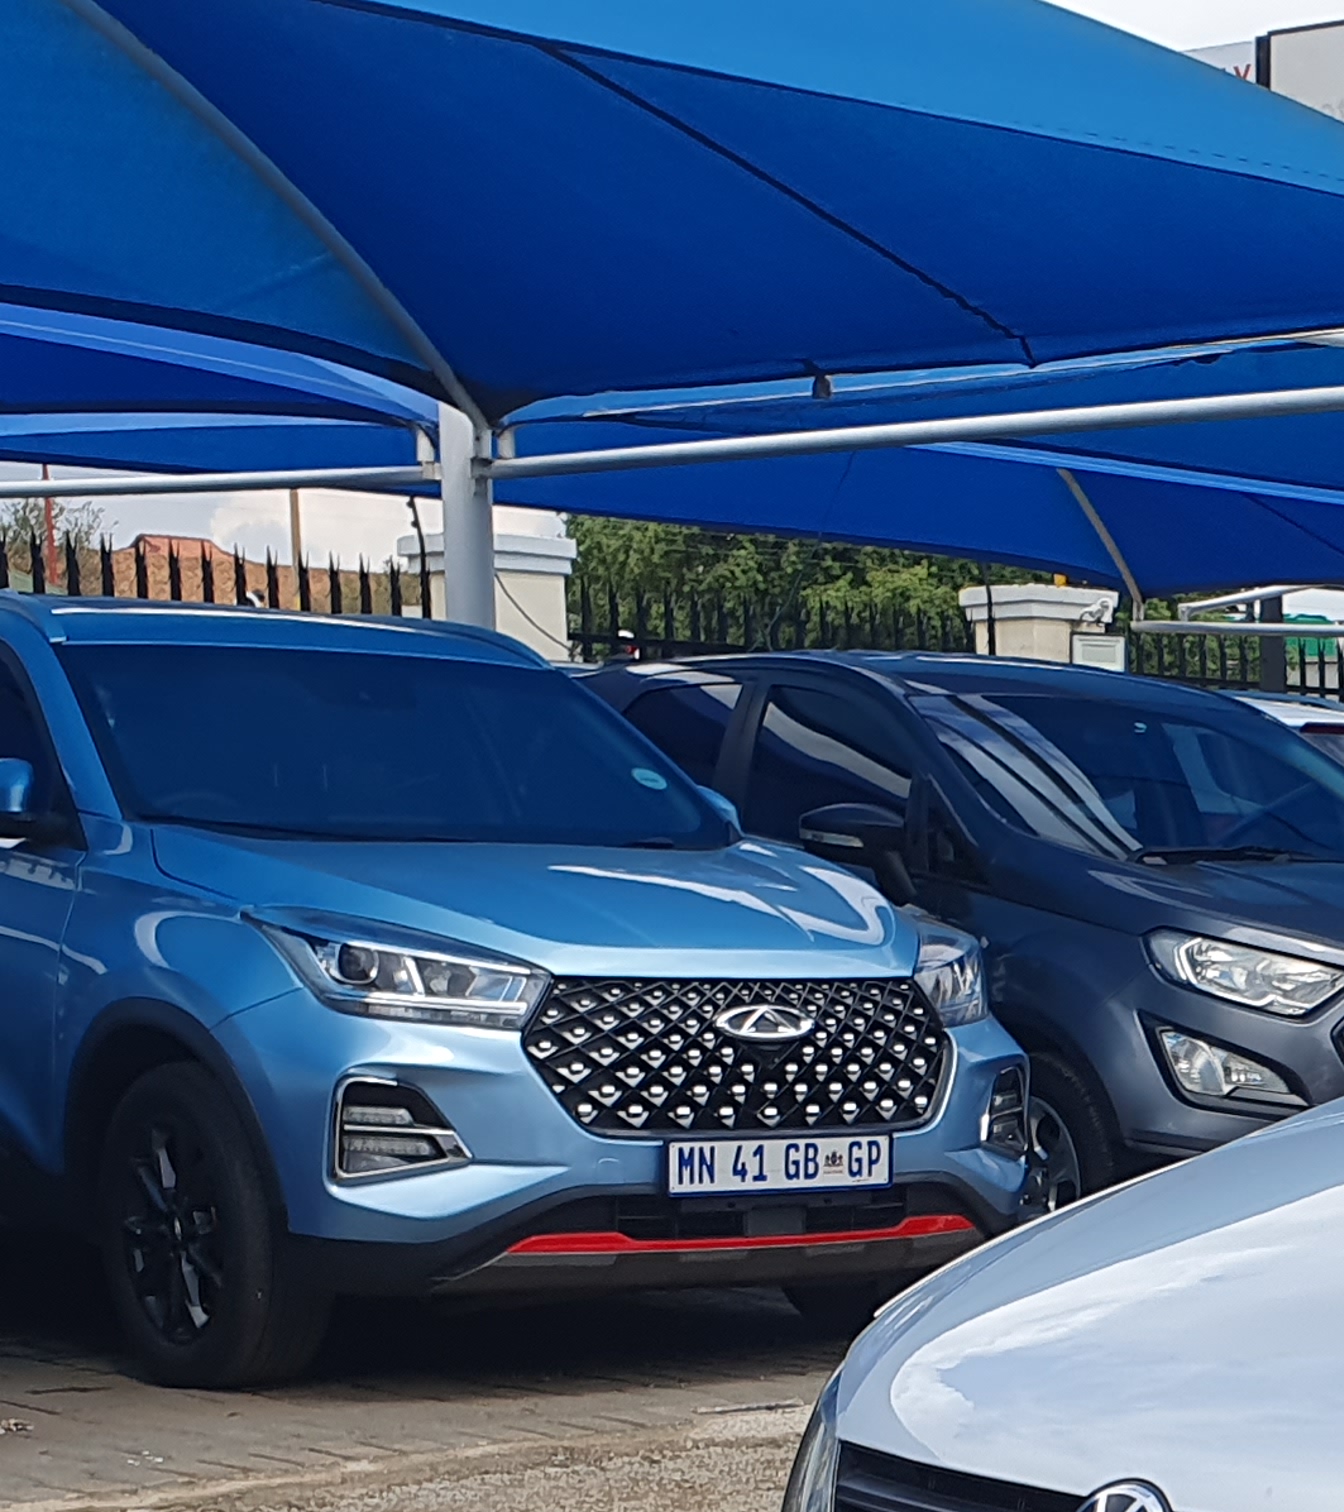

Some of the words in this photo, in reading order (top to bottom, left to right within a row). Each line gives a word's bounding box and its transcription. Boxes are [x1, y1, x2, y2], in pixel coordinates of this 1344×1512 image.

[677, 1146, 716, 1186] MN
[731, 1144, 769, 1183] 41
[784, 1142, 820, 1181] GB
[847, 1140, 882, 1178] GP
